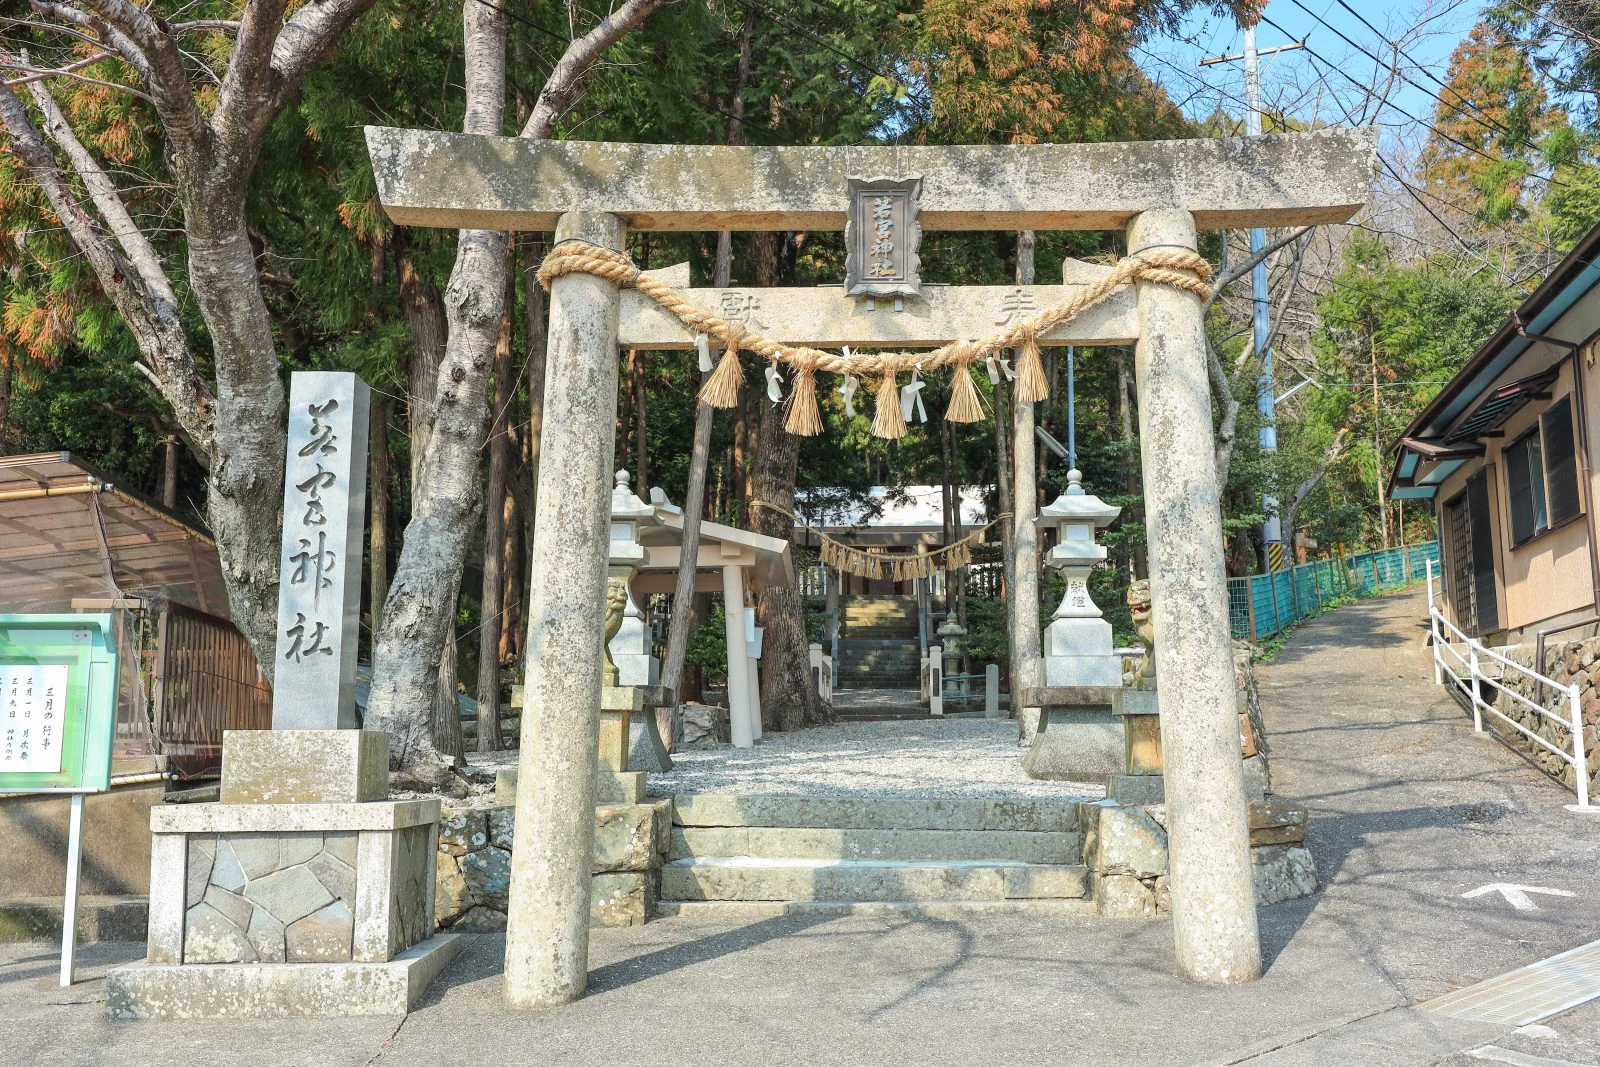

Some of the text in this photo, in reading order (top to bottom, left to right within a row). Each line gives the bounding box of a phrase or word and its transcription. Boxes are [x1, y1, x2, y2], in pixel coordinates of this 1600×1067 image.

[869, 195, 897, 277] 若宮神社
[285, 398, 339, 664] 若宮神社
[9, 677, 18, 718] 三月九日
[20, 677, 33, 760] 三月一日 月次祭
[41, 687, 54, 750] 三月の行事
